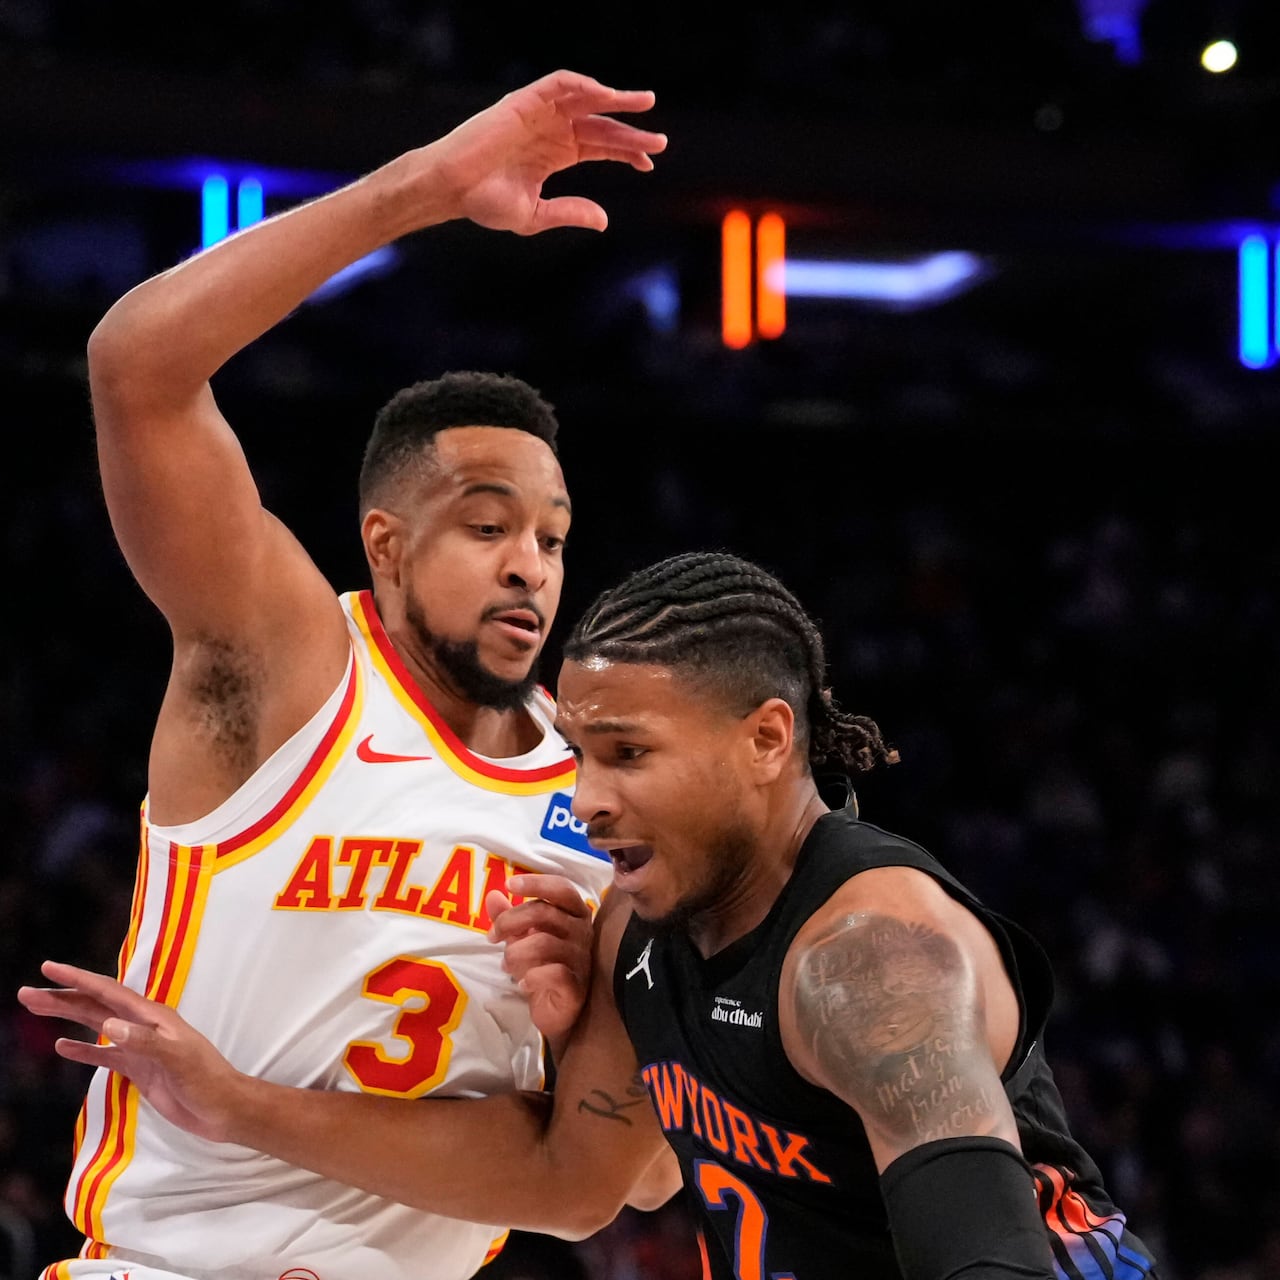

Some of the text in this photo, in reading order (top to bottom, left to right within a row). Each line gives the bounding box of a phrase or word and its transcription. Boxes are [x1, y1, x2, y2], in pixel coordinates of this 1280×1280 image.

[272, 836, 598, 934] ATLAN
[344, 957, 467, 1098] 3
[711, 1005, 763, 1027] abu dhabi
